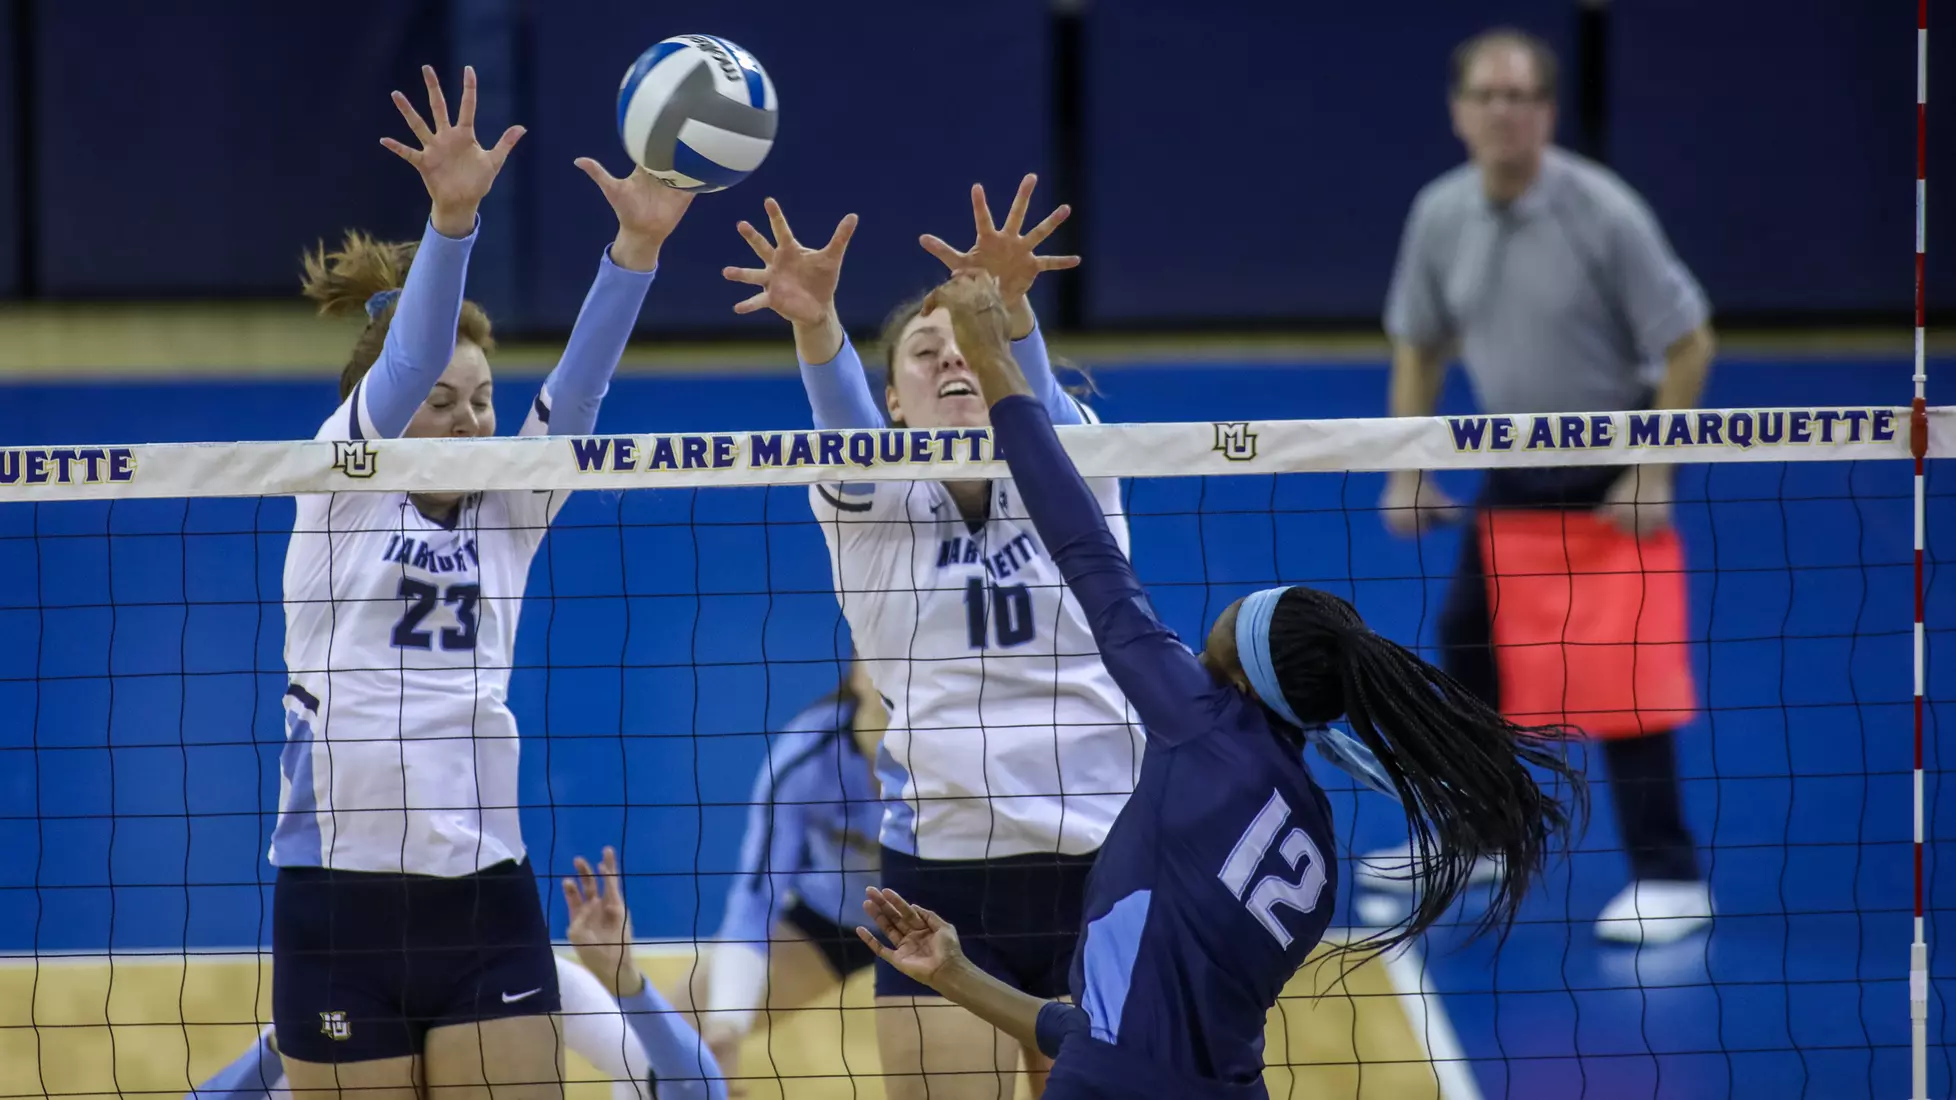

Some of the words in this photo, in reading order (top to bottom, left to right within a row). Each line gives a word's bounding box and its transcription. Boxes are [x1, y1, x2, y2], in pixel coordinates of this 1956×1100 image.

[569, 438, 638, 472] WE
[645, 434, 738, 471] ARE
[1448, 416, 1516, 451] WE
[1524, 414, 1614, 449] ARE
[1625, 408, 1896, 450] MARQUETTE
[0, 447, 137, 485] UETTE
[390, 576, 481, 651] 23
[964, 576, 1035, 649] 10
[1217, 787, 1327, 951] 12
